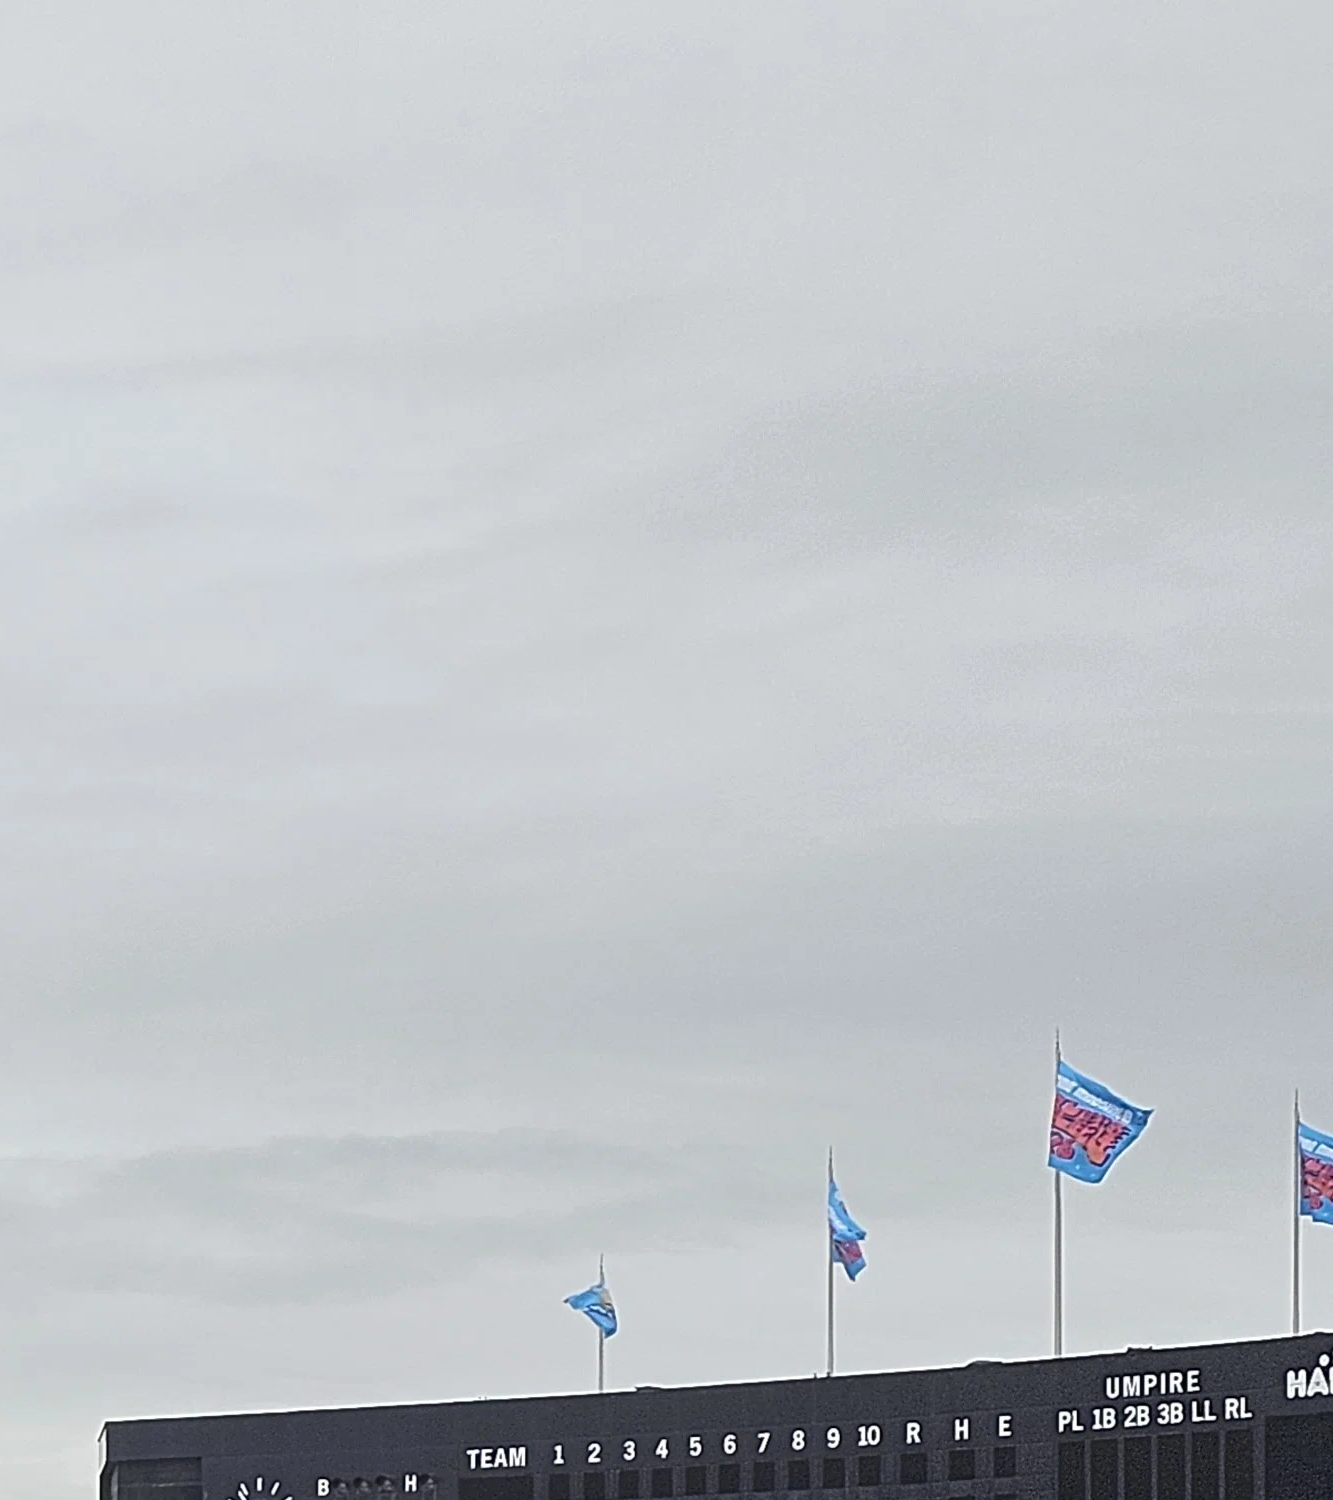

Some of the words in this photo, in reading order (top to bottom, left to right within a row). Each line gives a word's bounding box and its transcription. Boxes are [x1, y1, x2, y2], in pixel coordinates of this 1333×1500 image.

[1106, 1370, 1200, 1399] UMPIRE
[1058, 1410, 1084, 1433] PL
[1092, 1407, 1116, 1430] 1B
[1124, 1405, 1150, 1428] 2B
[1157, 1402, 1184, 1425] 3B
[1191, 1400, 1217, 1422] LL
[1224, 1397, 1253, 1420] RL
[466, 1446, 526, 1470] TEAM
[553, 1445, 565, 1465] 1
[587, 1443, 601, 1463] 2
[623, 1440, 636, 1461] 3
[655, 1438, 669, 1459] 4
[689, 1436, 702, 1457] 5
[723, 1434, 736, 1455] 6
[757, 1432, 771, 1453] 7
[791, 1429, 805, 1451] 8
[827, 1427, 841, 1449] 9
[858, 1425, 881, 1447] 10
[906, 1422, 921, 1444] R
[954, 1418, 969, 1441] H
[998, 1415, 1012, 1437] E
[317, 1478, 330, 1497] B
[404, 1474, 417, 1492] H
